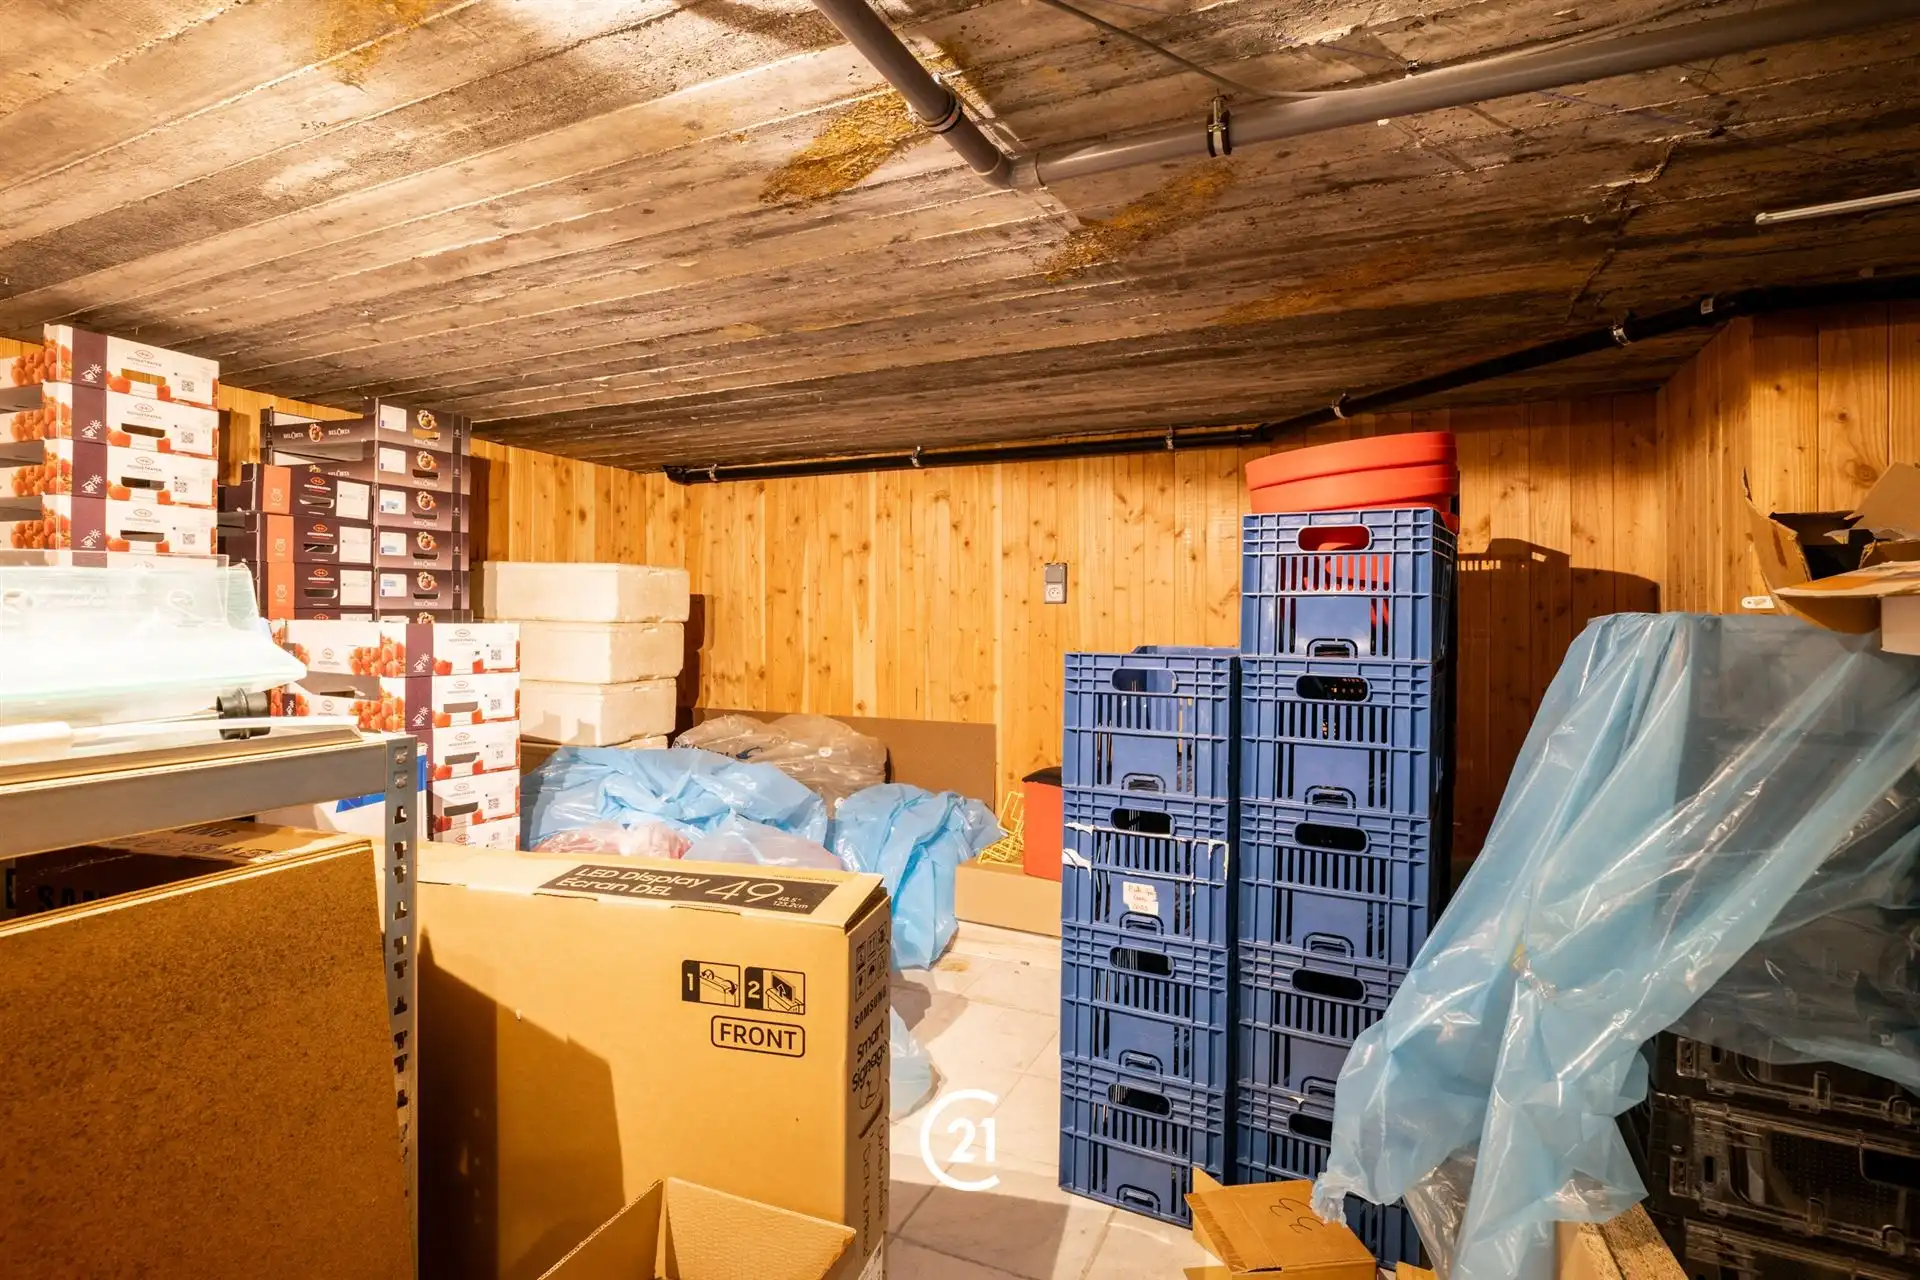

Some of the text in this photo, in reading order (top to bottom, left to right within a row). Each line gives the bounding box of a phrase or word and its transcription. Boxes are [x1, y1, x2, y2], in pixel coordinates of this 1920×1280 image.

[556, 876, 673, 896] Écran DEL
[575, 867, 710, 889] LED Display
[705, 880, 784, 903] 49
[687, 972, 694, 992] 1
[748, 980, 760, 999] 2
[854, 984, 887, 1030] SAMSUNG
[720, 1022, 797, 1050] FRONT
